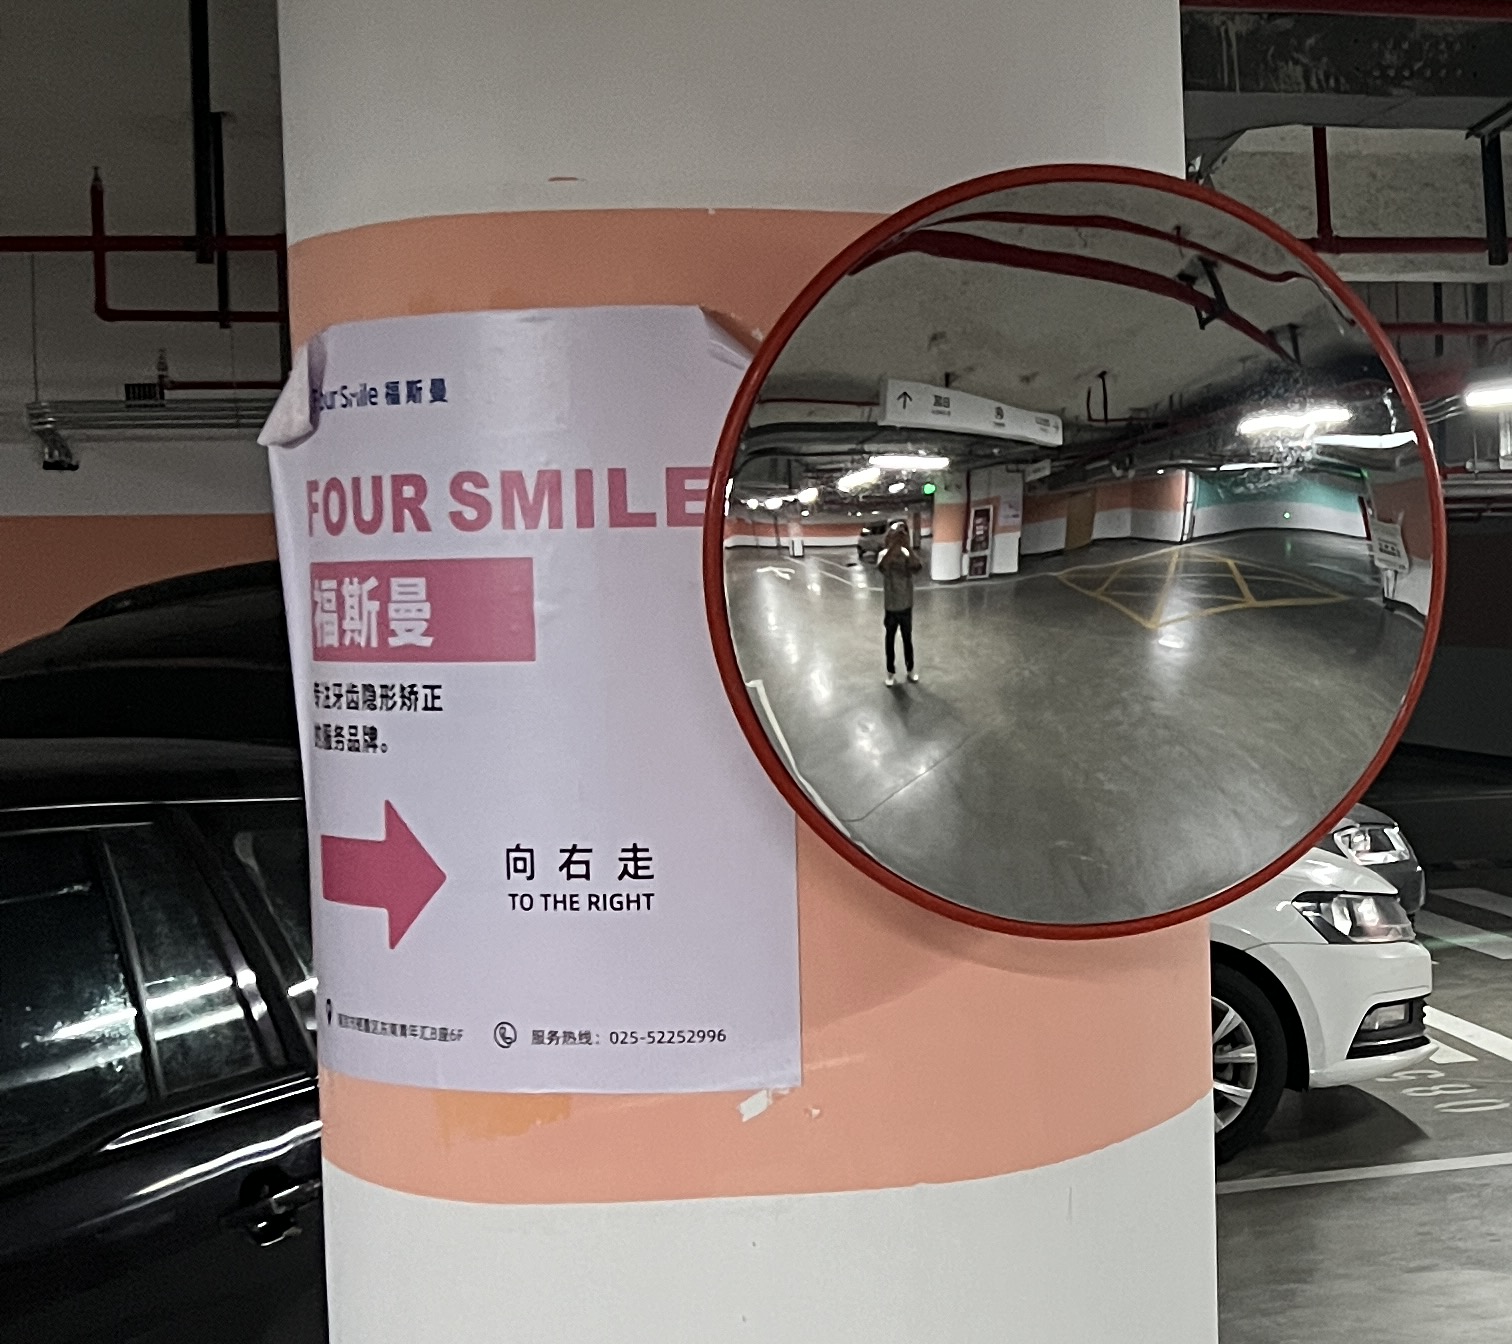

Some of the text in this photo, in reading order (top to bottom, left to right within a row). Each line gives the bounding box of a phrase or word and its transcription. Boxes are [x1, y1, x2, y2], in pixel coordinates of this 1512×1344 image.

[306, 467, 712, 537] FOUR SMILE
[313, 576, 435, 647] 福斯曼
[506, 843, 655, 881] 向右走
[508, 892, 655, 912] TO THE RIGHT
[609, 1028, 727, 1045] 025-52252996
